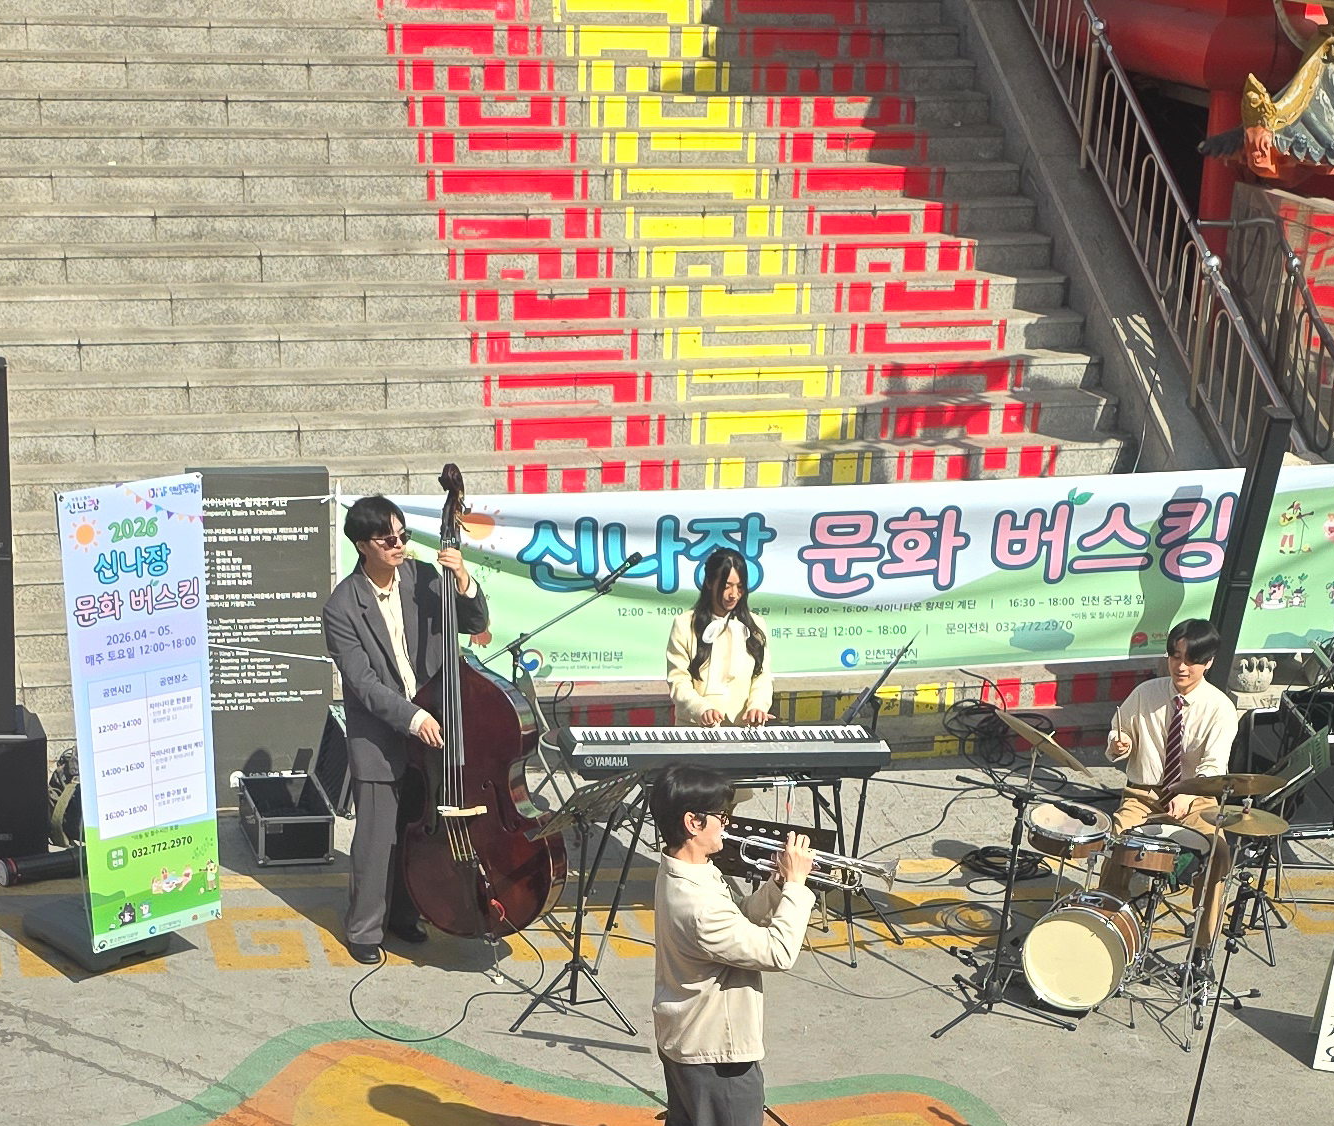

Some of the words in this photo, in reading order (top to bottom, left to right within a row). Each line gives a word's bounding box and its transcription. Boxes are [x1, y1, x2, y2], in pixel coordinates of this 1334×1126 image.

[108, 517, 159, 544] 2026
[517, 511, 777, 595] 신나장
[797, 504, 971, 599] 문화
[990, 490, 1241, 585] 버스킹
[94, 542, 172, 585] 신나장
[73, 590, 124, 628] 문화
[129, 576, 200, 615] 버스킹
[618, 607, 644, 617] 12:00
[657, 607, 684, 616] 14:00
[803, 606, 830, 614] 14:00
[843, 605, 869, 613] 16:00
[957, 600, 977, 610] 계단
[1009, 598, 1036, 608] 16:30
[1048, 597, 1075, 607] 18:00
[1081, 595, 1100, 606] 인천
[1103, 594, 1132, 606] 중구청
[1135, 594, 1145, 605] 앞
[106, 629, 147, 646] 2026.04
[158, 625, 174, 637] 05.
[771, 627, 793, 639] 매주
[796, 626, 828, 638] 토요일
[833, 626, 863, 637] 12:00
[877, 625, 907, 636] 18:00
[946, 622, 989, 635] 문의전화
[995, 620, 1073, 633] 032.772.2970
[85, 652, 104, 667] 매주
[107, 646, 135, 662] 토요일
[549, 651, 624, 663] 중소벤처기업부
[159, 673, 189, 687] 공연장소
[103, 684, 132, 698] 공연시간
[595, 756, 629, 768] YAMAHA
[131, 835, 193, 859] 032.772.2970
